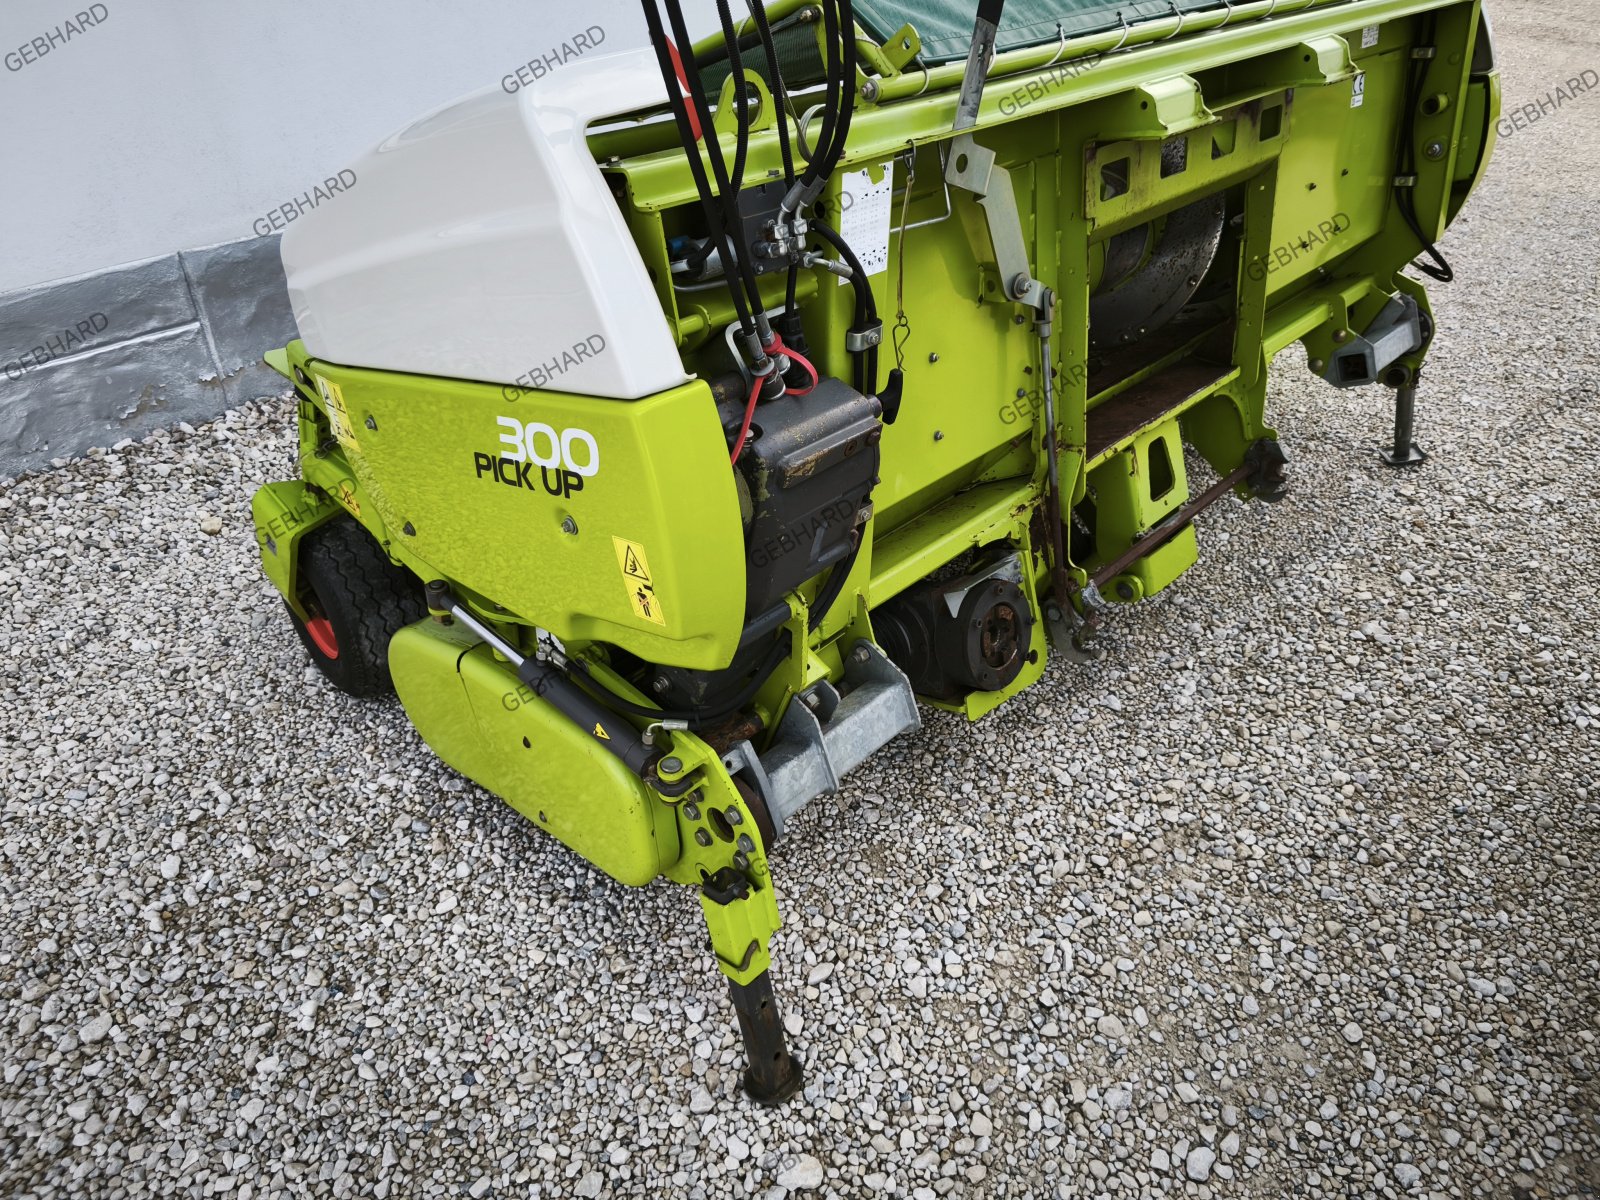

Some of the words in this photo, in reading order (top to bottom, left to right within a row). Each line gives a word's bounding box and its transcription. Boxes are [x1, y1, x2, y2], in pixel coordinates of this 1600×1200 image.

[496, 415, 600, 477] 300
[473, 451, 536, 491] PICK
[540, 465, 584, 499] UP
